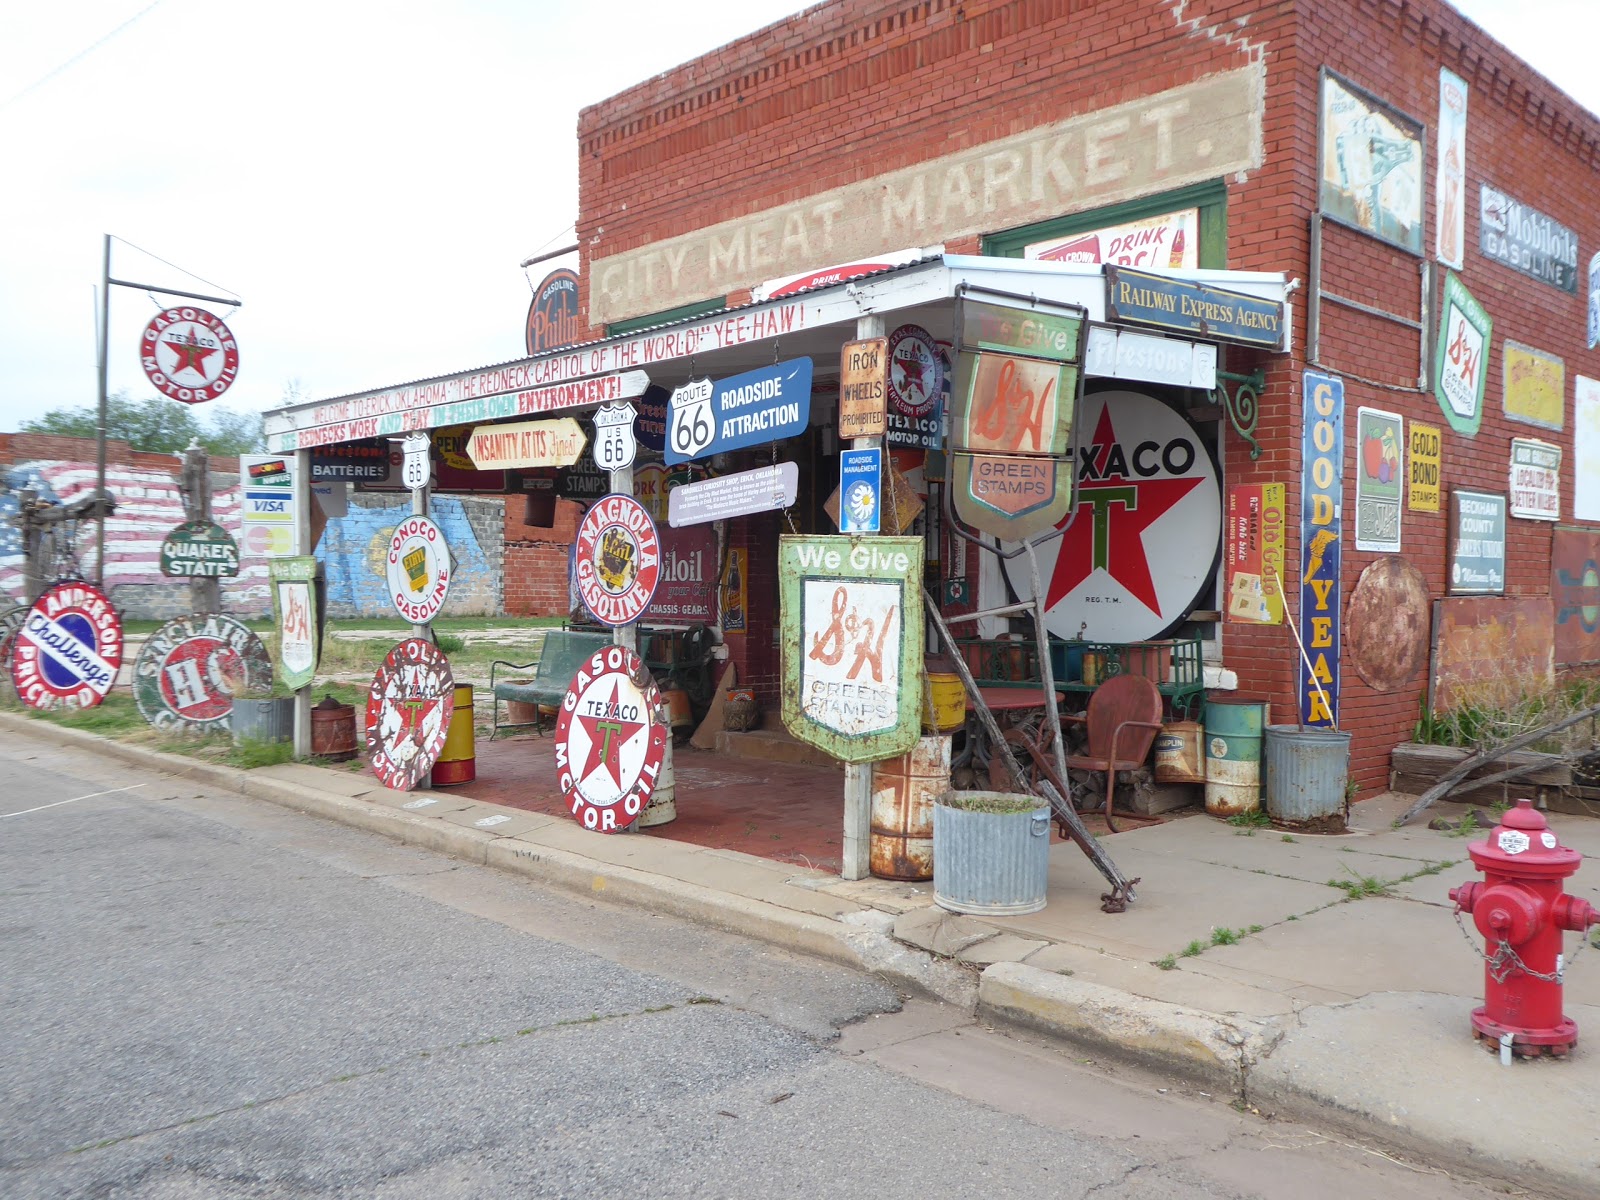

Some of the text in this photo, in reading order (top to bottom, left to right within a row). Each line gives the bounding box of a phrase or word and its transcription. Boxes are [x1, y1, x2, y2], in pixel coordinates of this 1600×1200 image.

[601, 248, 696, 301] CITY
[708, 202, 844, 279] MEAT
[1108, 226, 1168, 258] DRINK
[1065, 251, 1096, 264] CROWN
[1487, 233, 1563, 284] GASOLINE
[542, 279, 575, 300] GASOLINE
[812, 273, 842, 286] DRINK
[1119, 281, 1278, 332] RAILWAY EXPRESS AGENCY
[1451, 279, 1488, 332] We Give
[143, 308, 236, 352] GASOLINE
[167, 332, 215, 347] TEXACO
[1020, 319, 1068, 351] Give
[849, 351, 878, 371] IRON
[899, 348, 929, 362] TEXACO
[142, 356, 237, 401] MOTOR OIL
[314, 401, 351, 424] WELCOME
[353, 399, 363, 417] TO
[395, 383, 447, 409] OKLAHOMA
[480, 364, 531, 395] REDNECK
[535, 353, 586, 383] CAPITOL
[591, 349, 606, 372] OF
[613, 343, 638, 368] THE
[714, 316, 746, 345] YEE
[676, 384, 708, 404] ROUTE
[721, 377, 783, 410] ROADSIDE
[844, 381, 882, 401] WHEELS
[298, 424, 346, 447] REDNECKS
[349, 418, 378, 438] WORK
[380, 413, 401, 433] AND
[402, 408, 430, 431] PLAY
[433, 405, 446, 426] IN
[448, 400, 486, 424] THEIR
[488, 394, 517, 417] OWN
[518, 376, 622, 413] ENVIRONMENT!
[601, 411, 628, 425] OKLAHOMA
[721, 402, 799, 440] ATTRACTION
[842, 411, 882, 426] PROHIBITED
[676, 405, 709, 451] 66
[474, 433, 518, 461] INSANITY
[521, 431, 531, 458] AT
[533, 429, 546, 457] ITS
[549, 430, 577, 457] Finest
[604, 438, 624, 463] 66
[922, 435, 937, 447] OIL
[1412, 432, 1438, 457] GOLD
[848, 456, 873, 464] ROADSIDE
[1066, 437, 1196, 481] XACO
[312, 465, 385, 477] BATTERIES
[409, 463, 422, 482] 66
[979, 462, 1047, 479] GREEN
[1412, 461, 1438, 486] BOND
[567, 476, 606, 493] STAMPS
[726, 477, 739, 487] SHOP,
[977, 479, 1047, 495] STAMPS
[254, 501, 285, 511] VISA
[1411, 490, 1437, 503] STAMPS
[1460, 499, 1497, 515] BECKHAM
[581, 499, 658, 570] MAGNOLIA
[1461, 518, 1495, 533] COUNTY
[164, 542, 235, 559] QUAKER
[389, 520, 437, 564] CONOCO
[1239, 541, 1247, 561] SIZE
[1263, 506, 1281, 596] Old Gold
[169, 561, 230, 576] STATE
[403, 548, 426, 571] ETHYL
[797, 545, 909, 572] We Give
[291, 563, 312, 578] Give
[396, 568, 448, 620] GASOLINE
[579, 558, 650, 622] GASOLINE
[1085, 596, 1101, 604] REG.
[650, 604, 709, 615] CHASSIS GEARS
[47, 588, 118, 658] ANDERSON
[28, 614, 111, 687] Challenge
[139, 618, 249, 678] SINCLAIR
[812, 680, 888, 701] GREEN
[587, 700, 638, 722] TEXACO
[555, 743, 660, 830] MOTOR OIL
